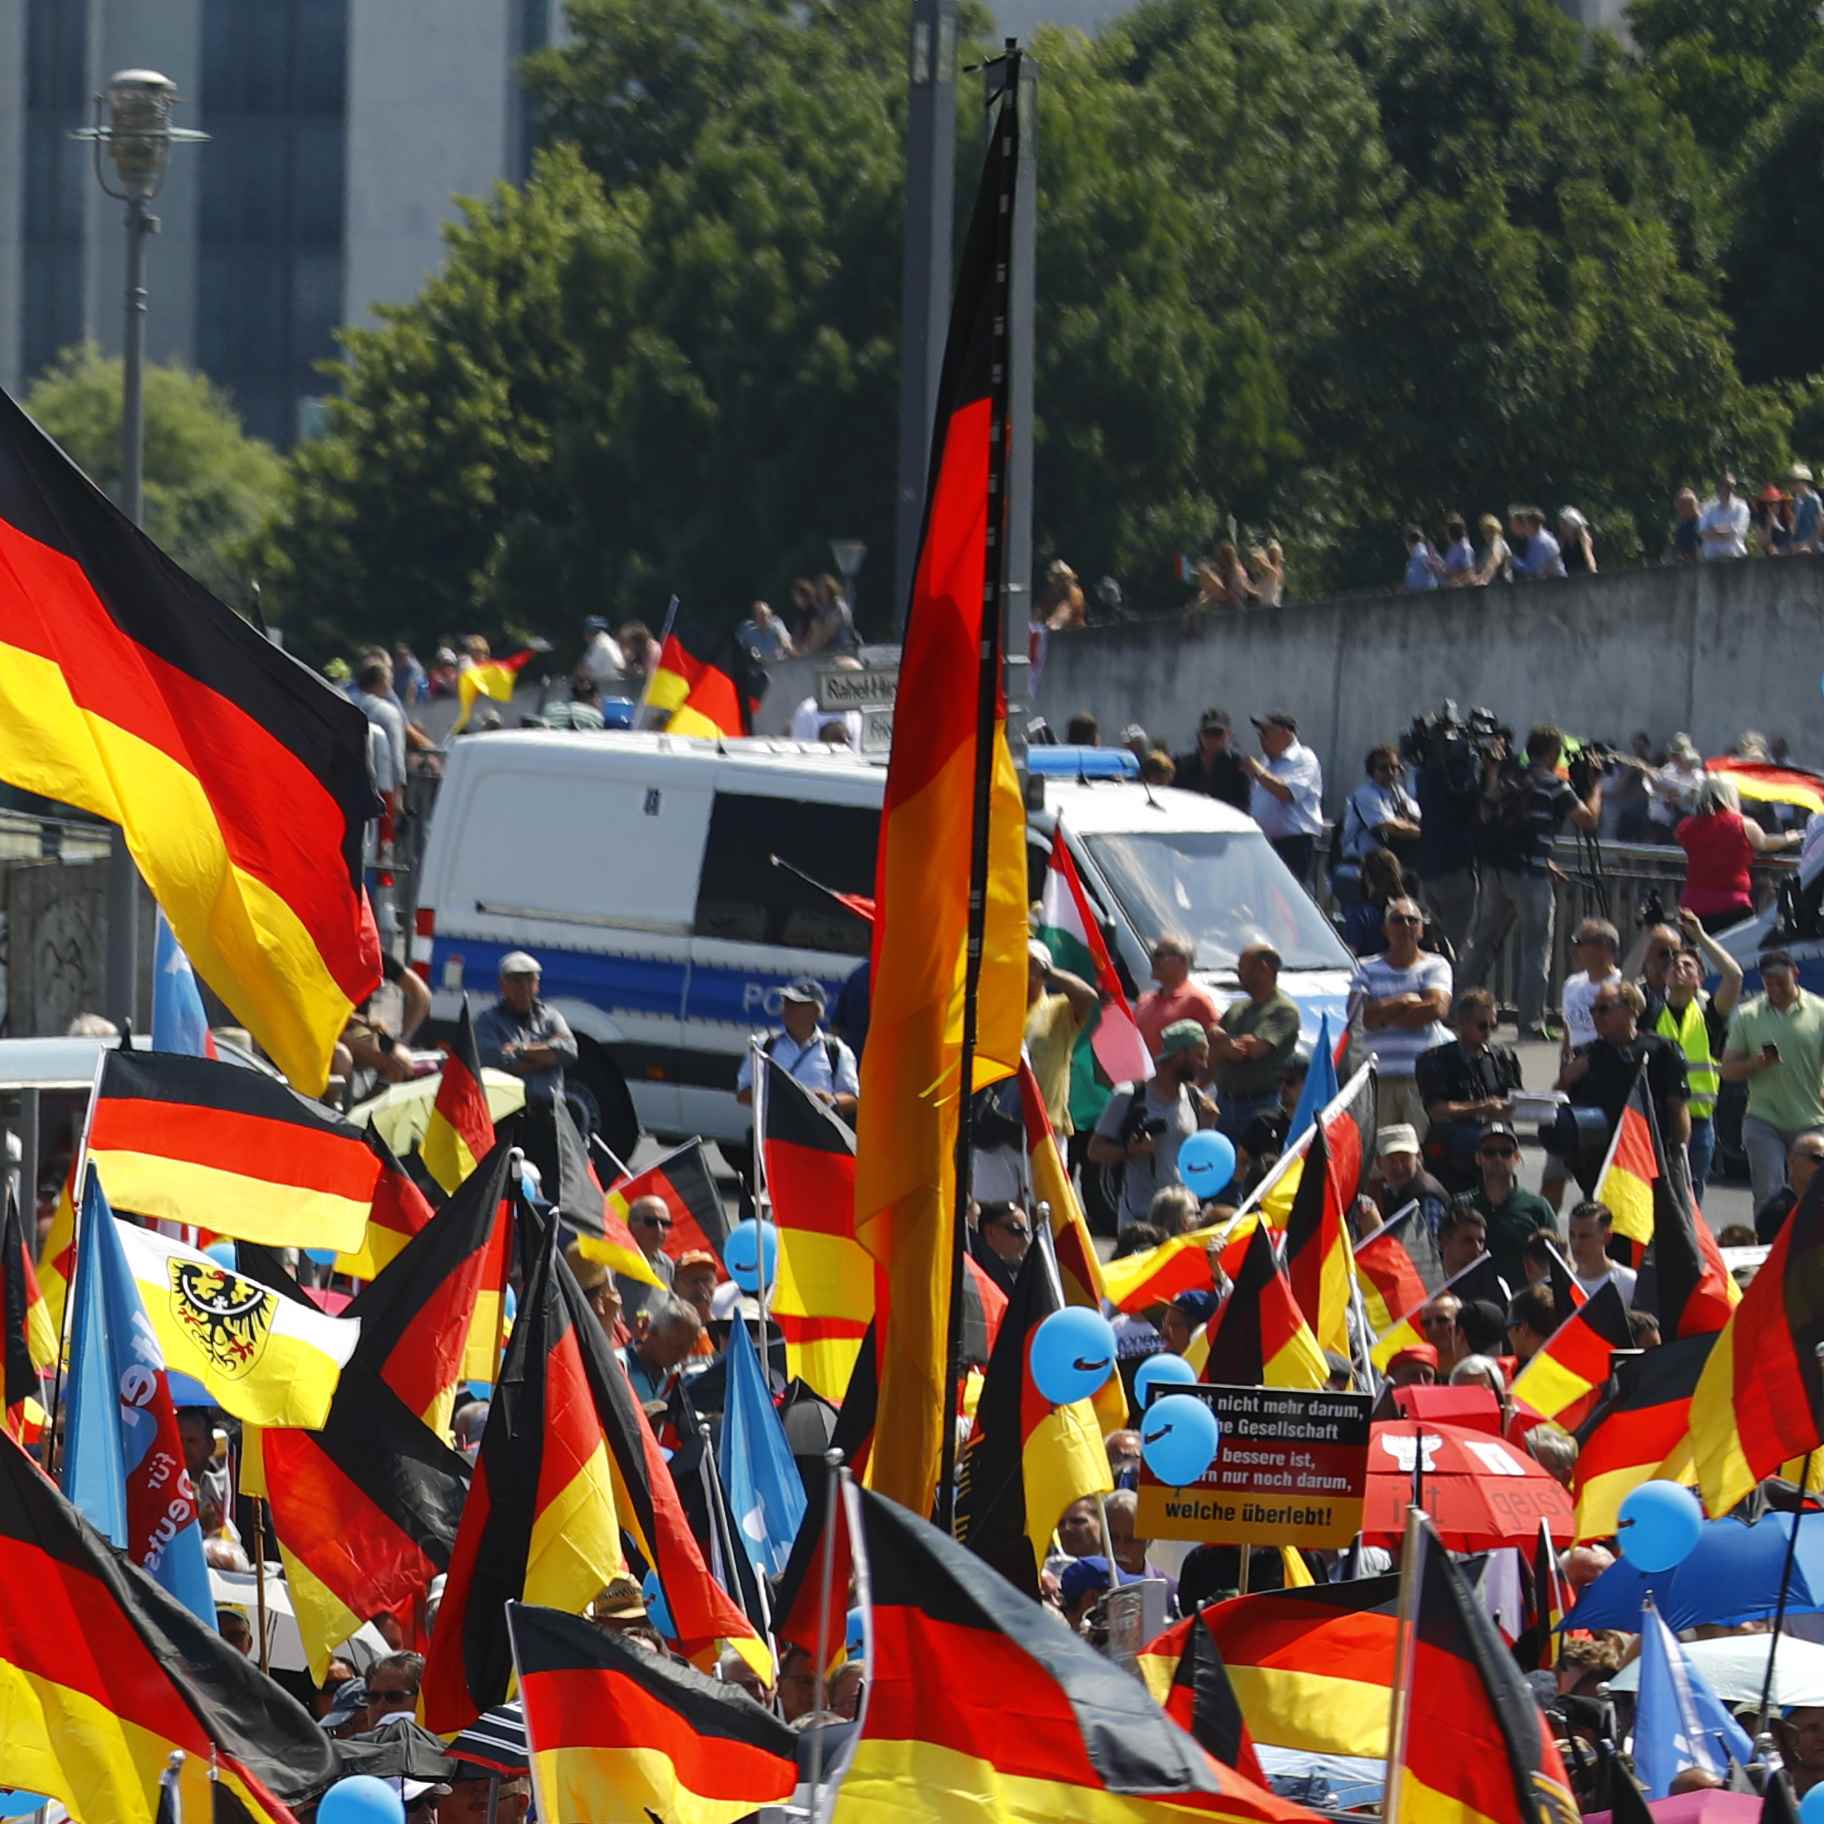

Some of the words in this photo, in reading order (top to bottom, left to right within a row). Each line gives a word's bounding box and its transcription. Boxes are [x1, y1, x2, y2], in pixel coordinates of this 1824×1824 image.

[1218, 1396, 1260, 1413] nicht
[1263, 1399, 1304, 1416] mehr
[1308, 1400, 1364, 1422] darum,
[1238, 1418, 1339, 1440] Gesellschaft
[1222, 1447, 1285, 1467] bessere
[1290, 1450, 1316, 1471] ist,
[1222, 1470, 1249, 1485] nur
[1253, 1471, 1294, 1488] noch
[1297, 1472, 1352, 1493] darum,
[1165, 1500, 1236, 1522] welche
[1241, 1503, 1332, 1527] überlebt!
